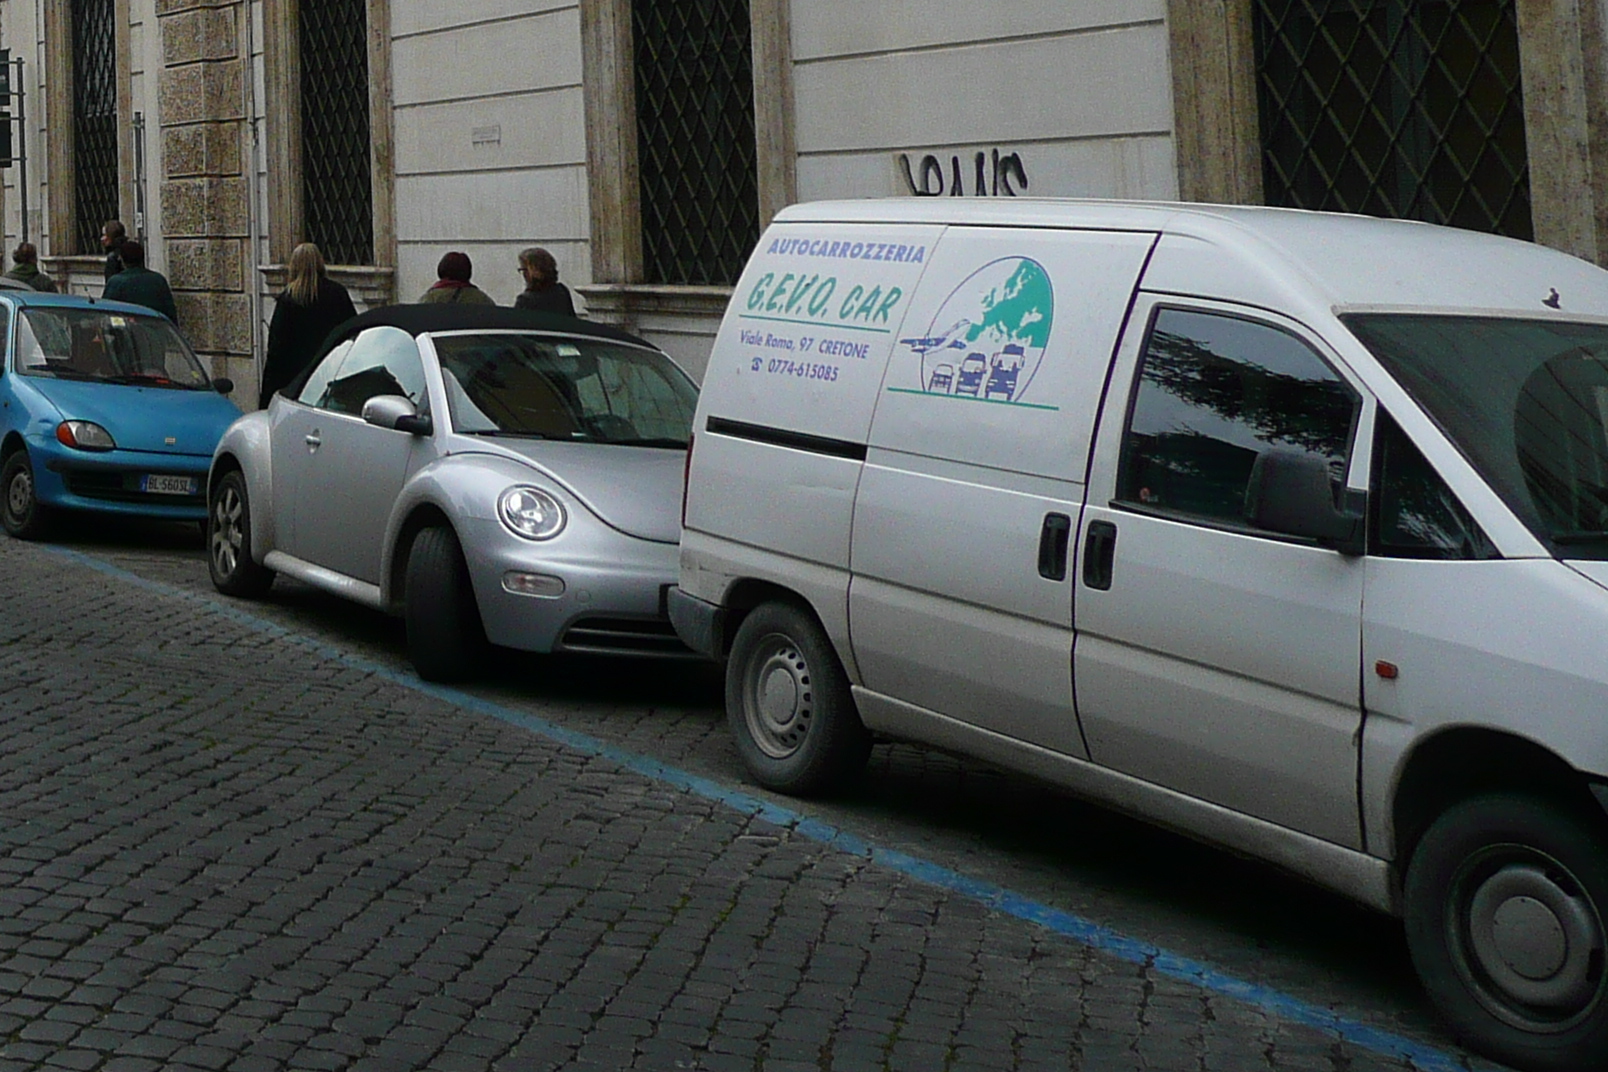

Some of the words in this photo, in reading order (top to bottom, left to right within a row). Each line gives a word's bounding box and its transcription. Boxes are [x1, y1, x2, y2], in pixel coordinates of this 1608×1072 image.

[767, 238, 925, 263] AUTOCARROZZERIA
[839, 285, 902, 323] CAR
[740, 331, 763, 346] Viale
[764, 334, 797, 352] Roma,
[799, 337, 813, 352] 97
[819, 339, 870, 359] CRETONE
[768, 359, 839, 382] 0774-615085
